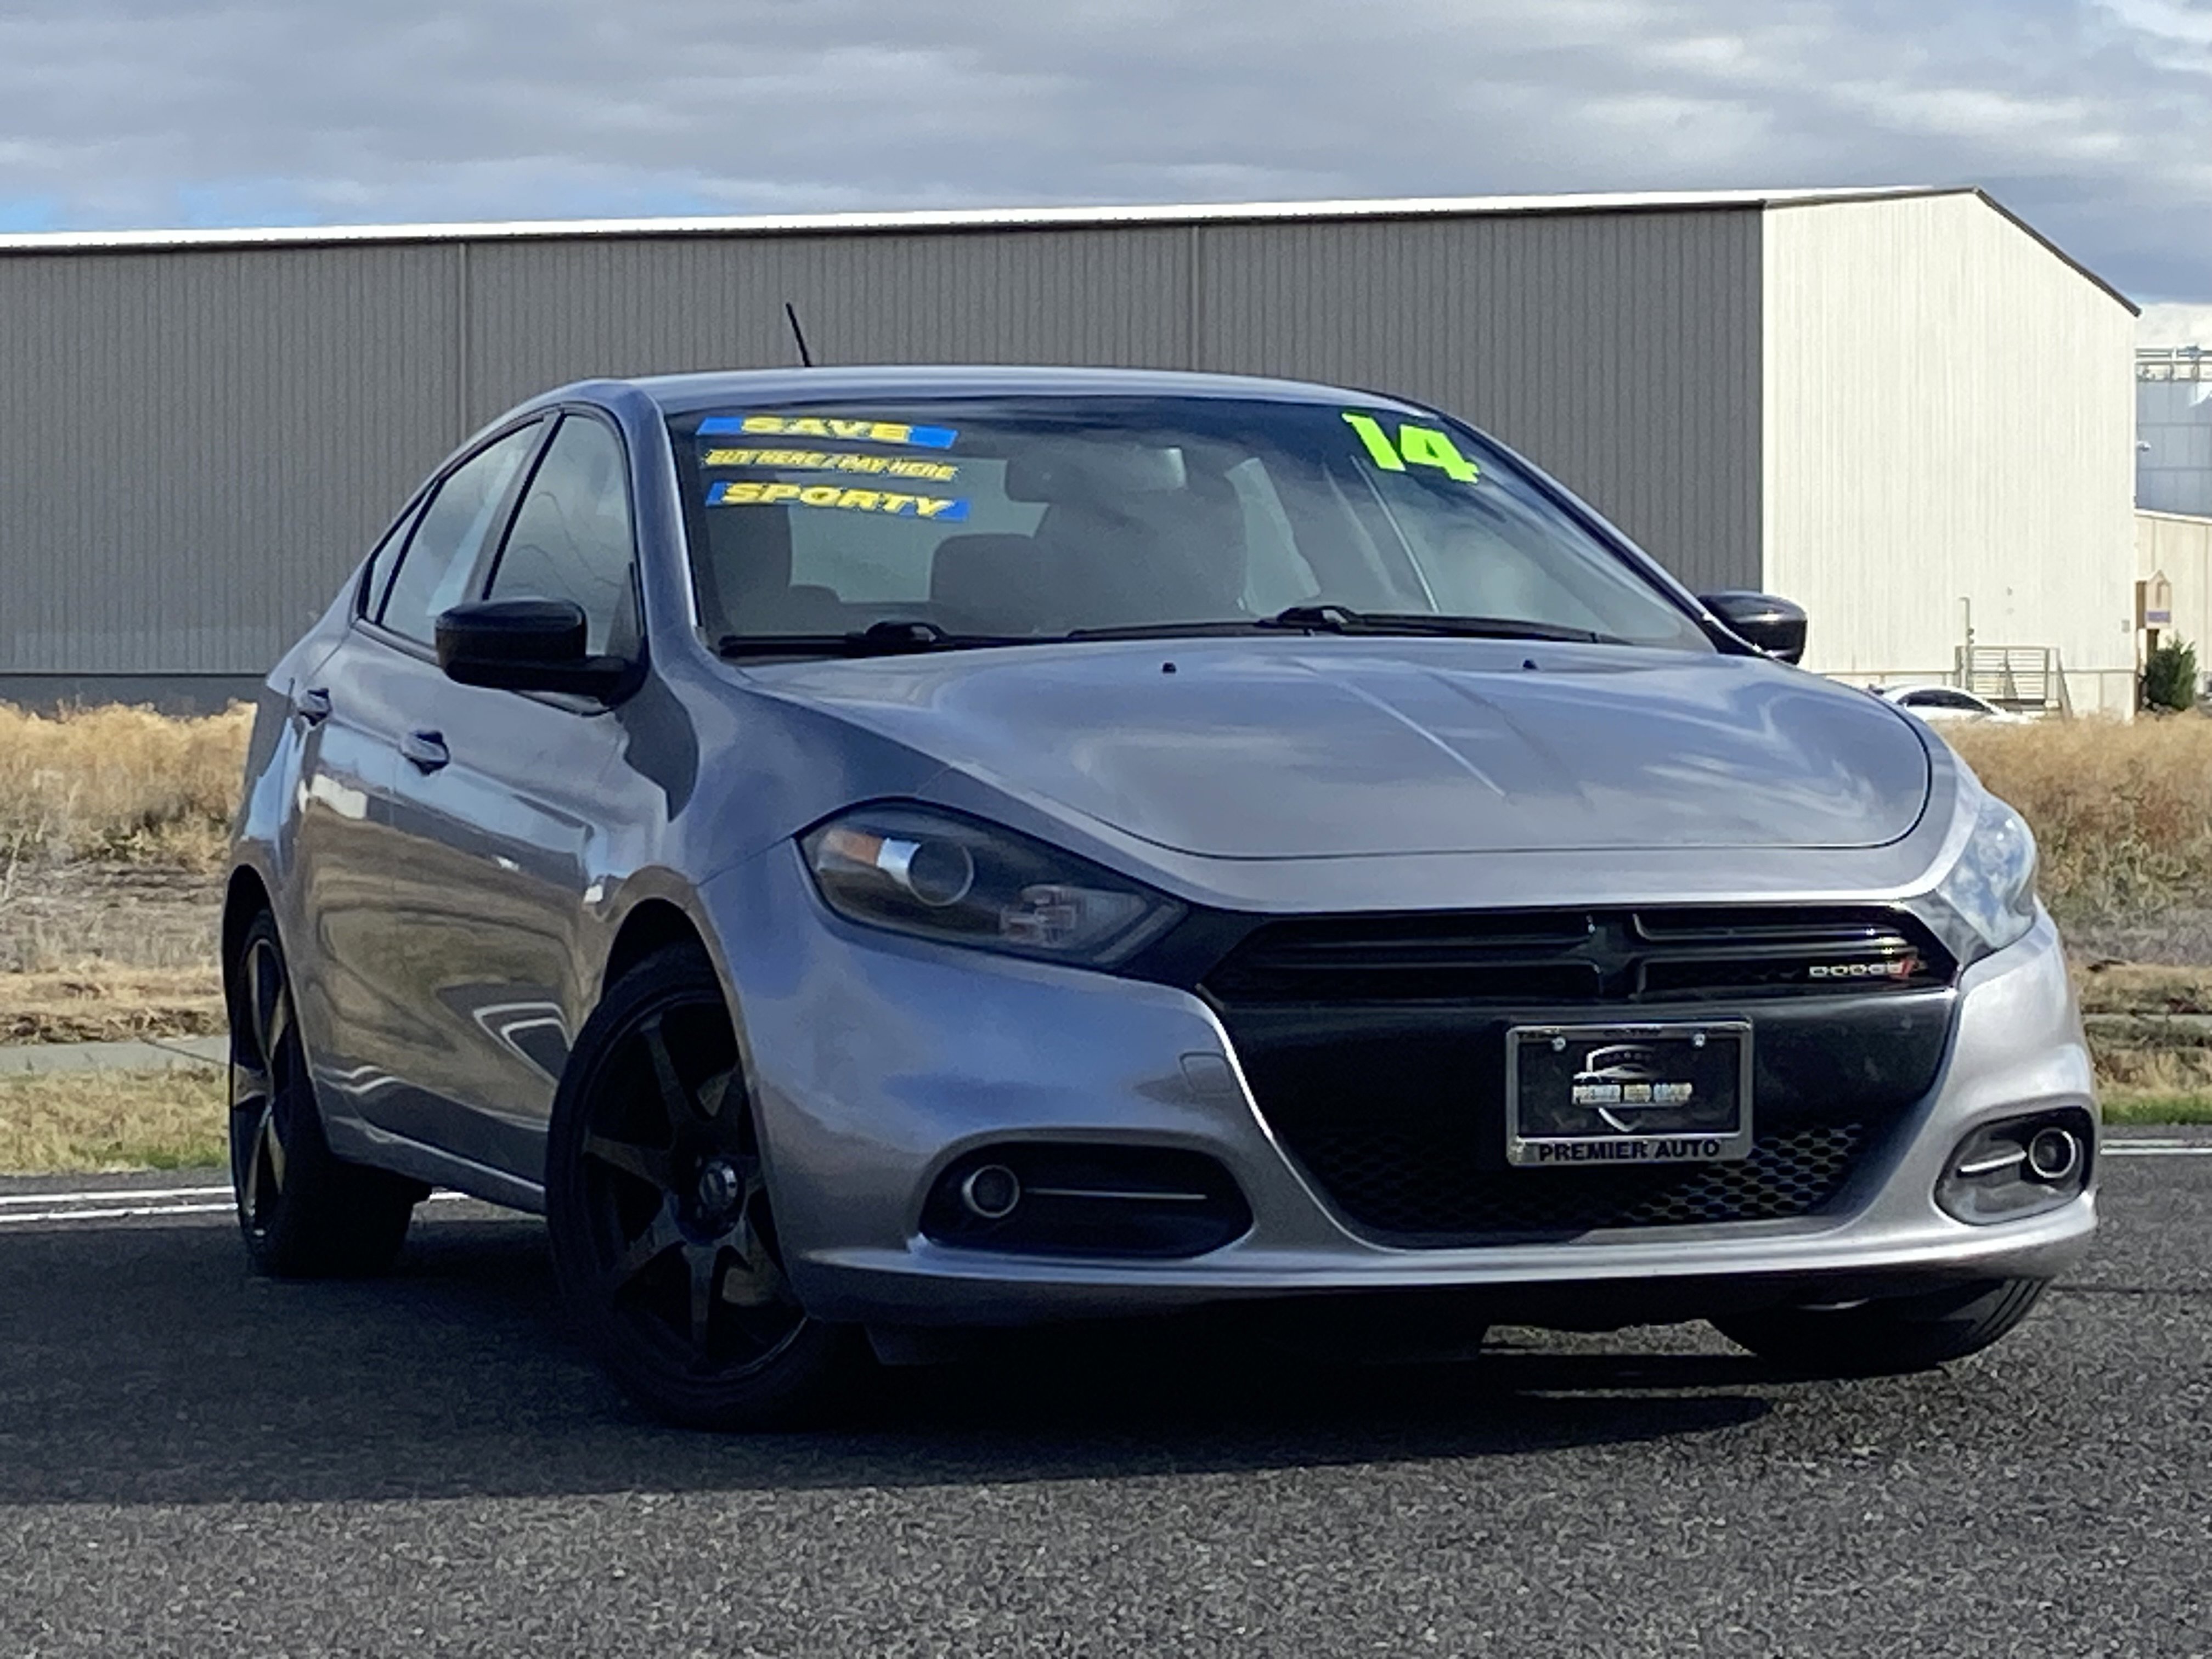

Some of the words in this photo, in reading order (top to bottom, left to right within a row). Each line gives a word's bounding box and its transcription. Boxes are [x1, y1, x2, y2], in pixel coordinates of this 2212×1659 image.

[741, 416, 910, 444] SAVE
[1341, 413, 1480, 484] 14
[706, 449, 754, 466] BUY
[887, 458, 958, 482] HERE
[722, 482, 955, 518] SPORTY
[1809, 961, 1903, 978] DODGE
[1539, 1141, 1647, 1162] PREMIER
[1654, 1138, 1720, 1159] AUTO
